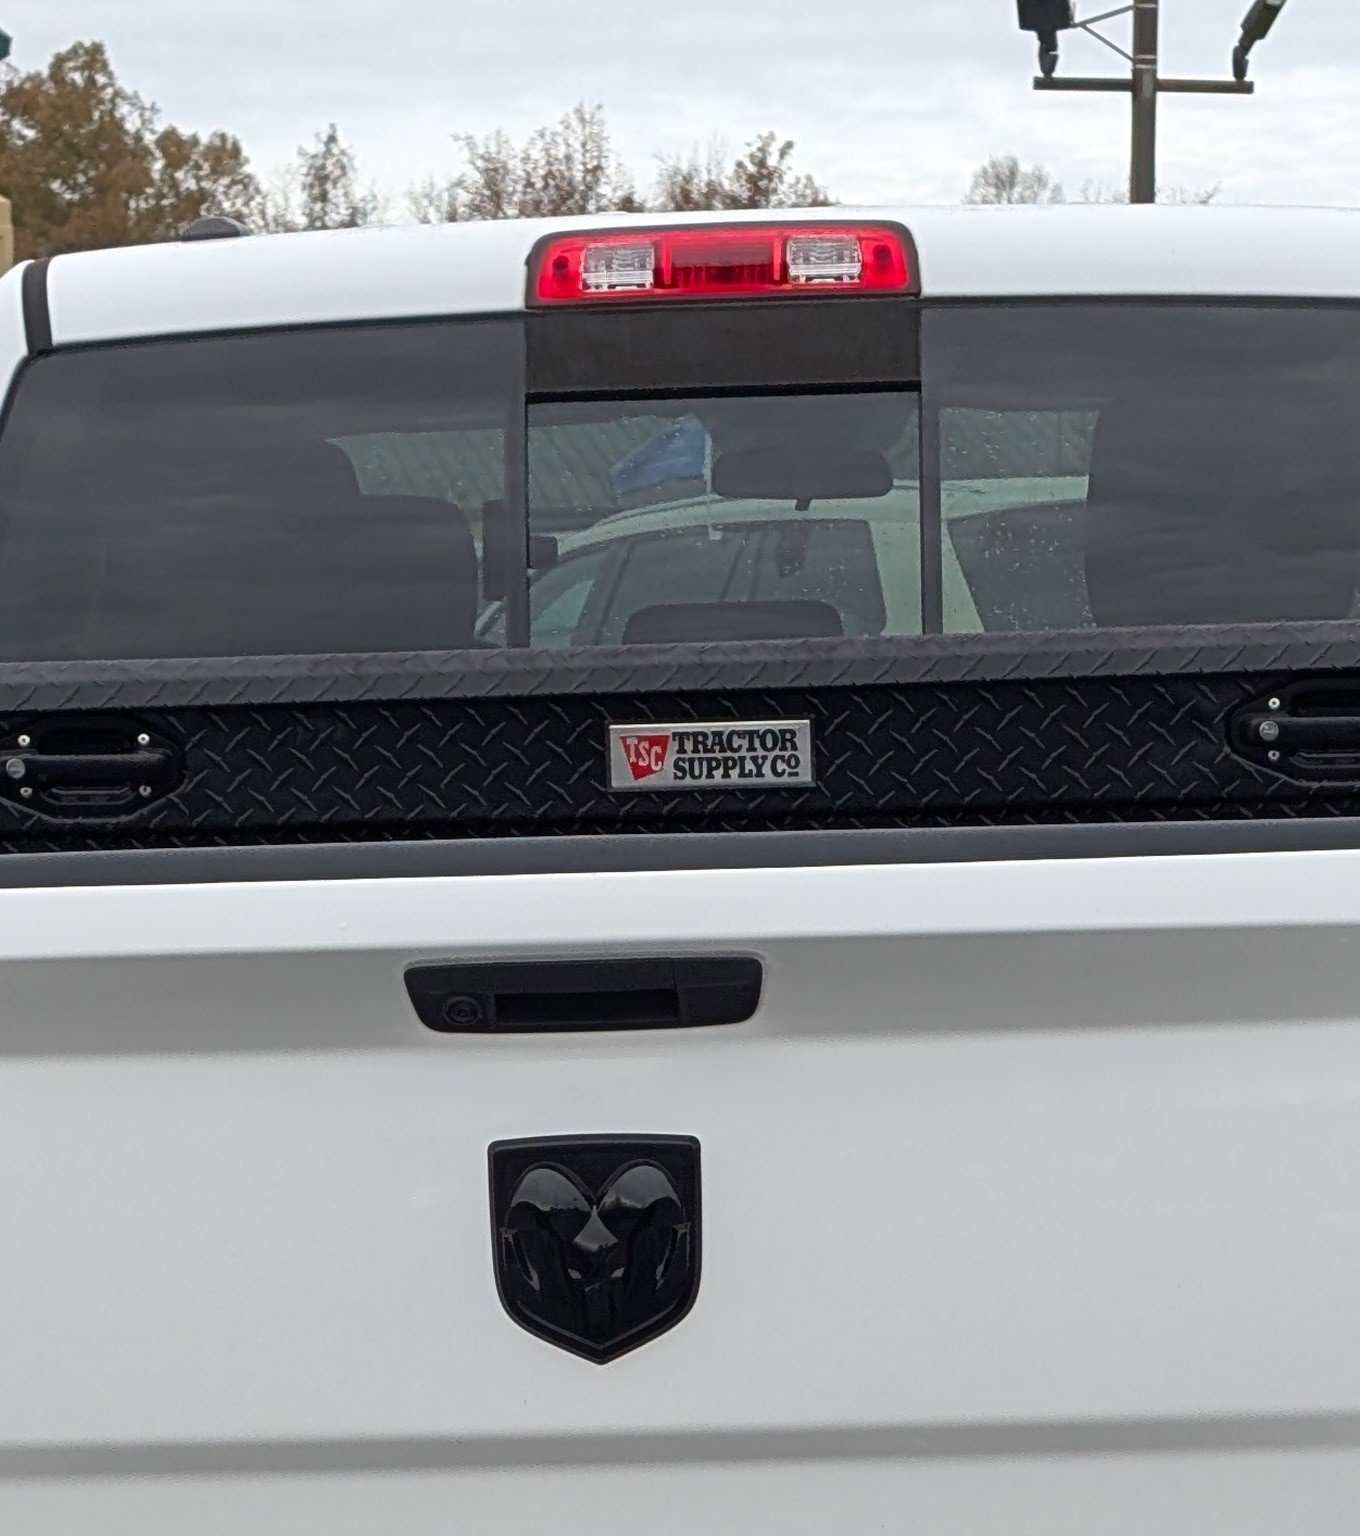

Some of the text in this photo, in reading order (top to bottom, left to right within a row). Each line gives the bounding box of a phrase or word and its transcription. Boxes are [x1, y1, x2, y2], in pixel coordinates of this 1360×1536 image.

[625, 736, 663, 771] TSC
[672, 728, 798, 754] TRACTOR
[673, 755, 768, 780] SUPPLY
